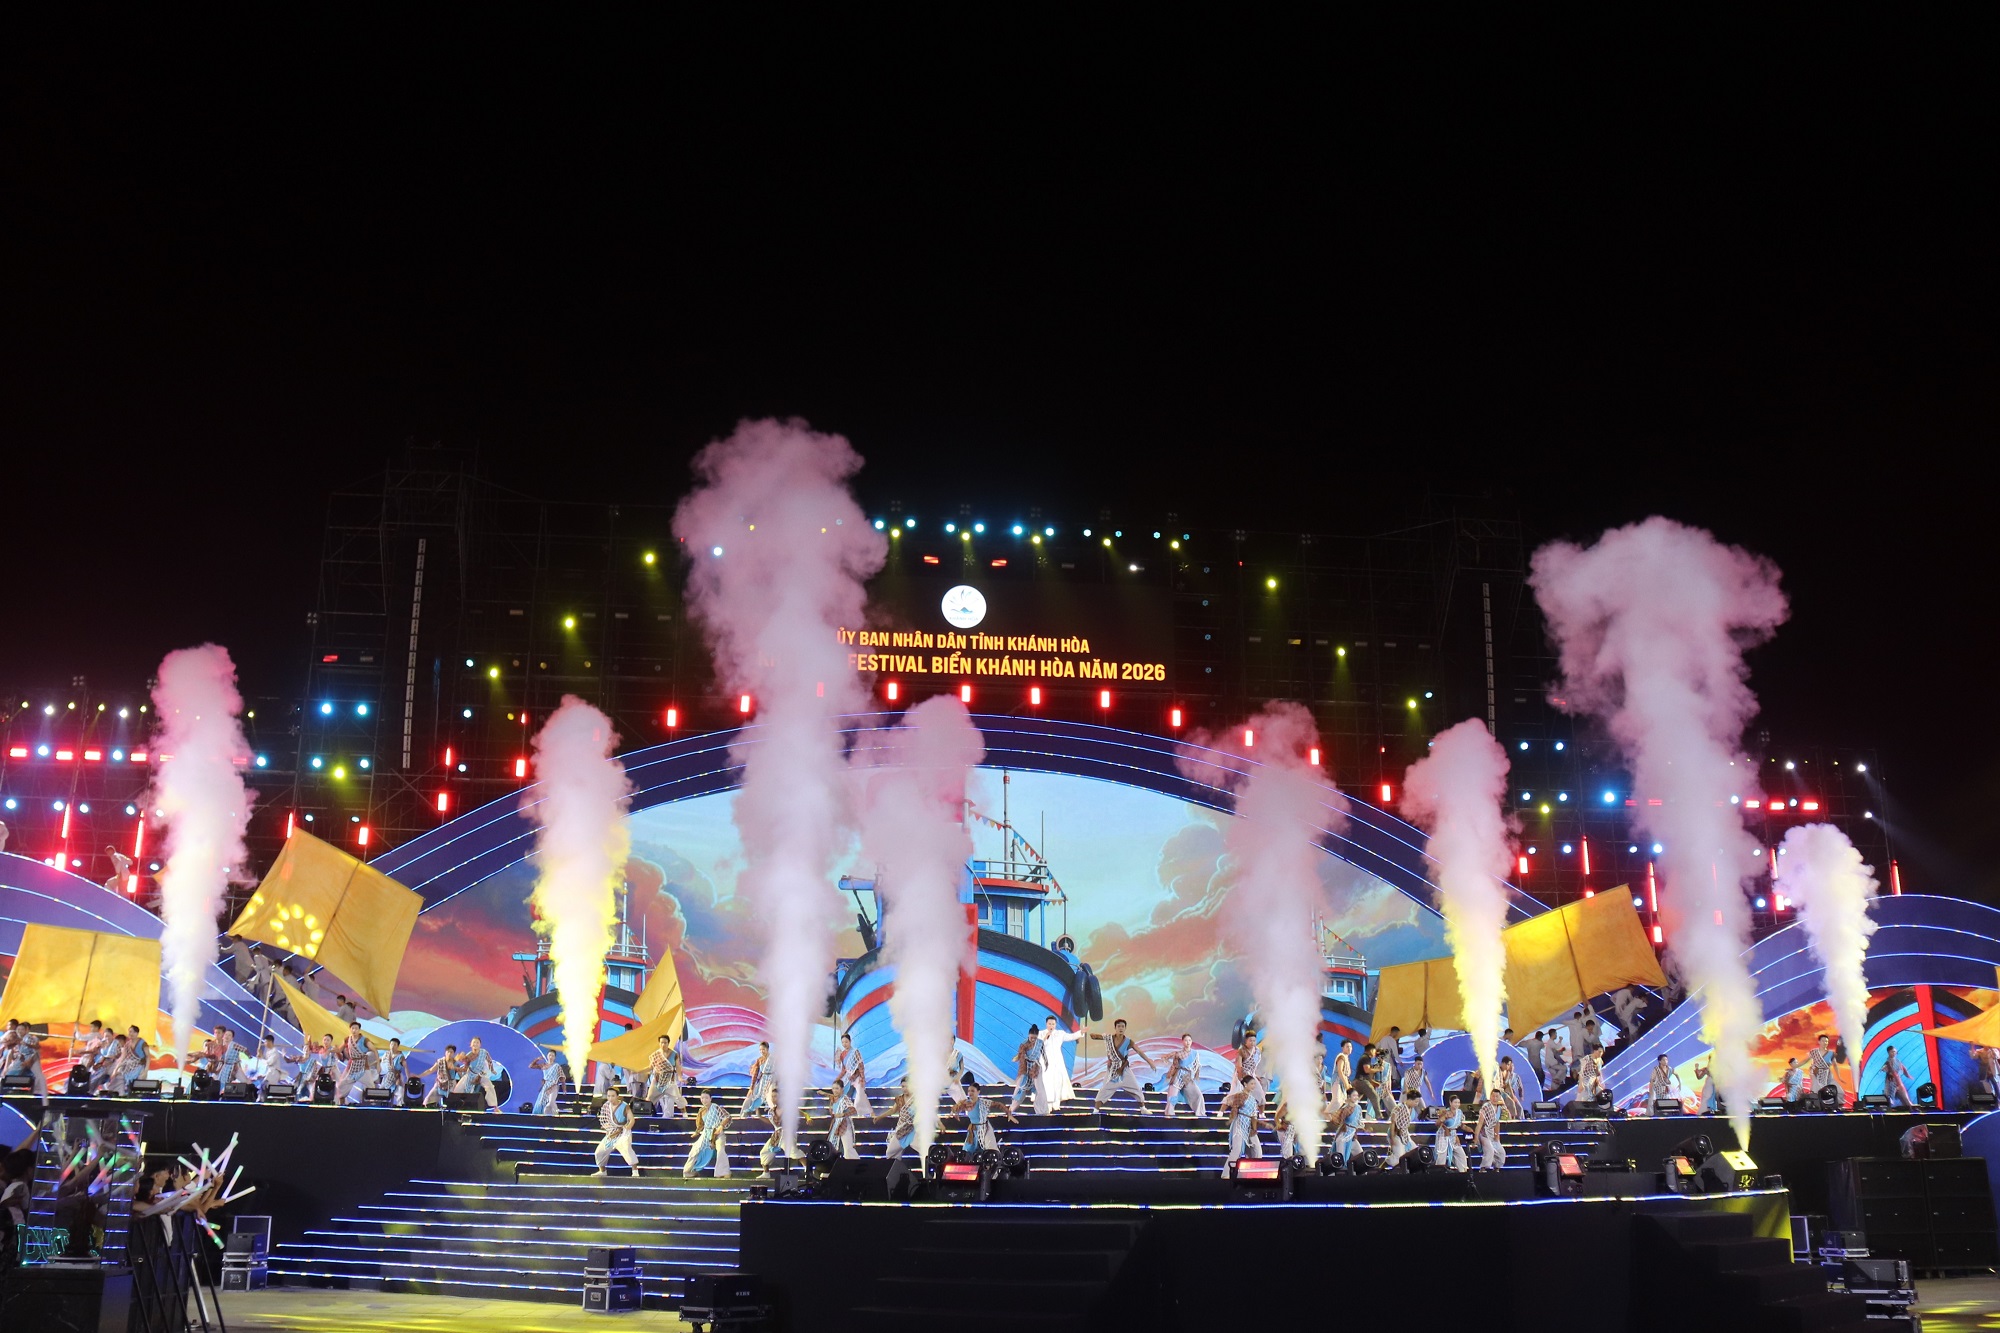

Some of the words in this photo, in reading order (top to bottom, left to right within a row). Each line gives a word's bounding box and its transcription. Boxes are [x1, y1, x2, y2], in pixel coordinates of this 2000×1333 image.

[836, 626, 856, 645] ỦY
[859, 631, 889, 647] BAN
[892, 630, 933, 648] NHÂN
[936, 631, 967, 650] DÂN
[969, 631, 1004, 650] TỈNH
[1007, 634, 1058, 653] KHÁNH
[1060, 635, 1090, 654] HÒA
[847, 652, 928, 673] FESTIVAL
[931, 651, 972, 675] BIỂN
[976, 655, 1036, 677] KHÁNH
[1040, 656, 1076, 678] HÒA
[1079, 658, 1118, 680] NĂM
[1121, 662, 1166, 682] 2026
